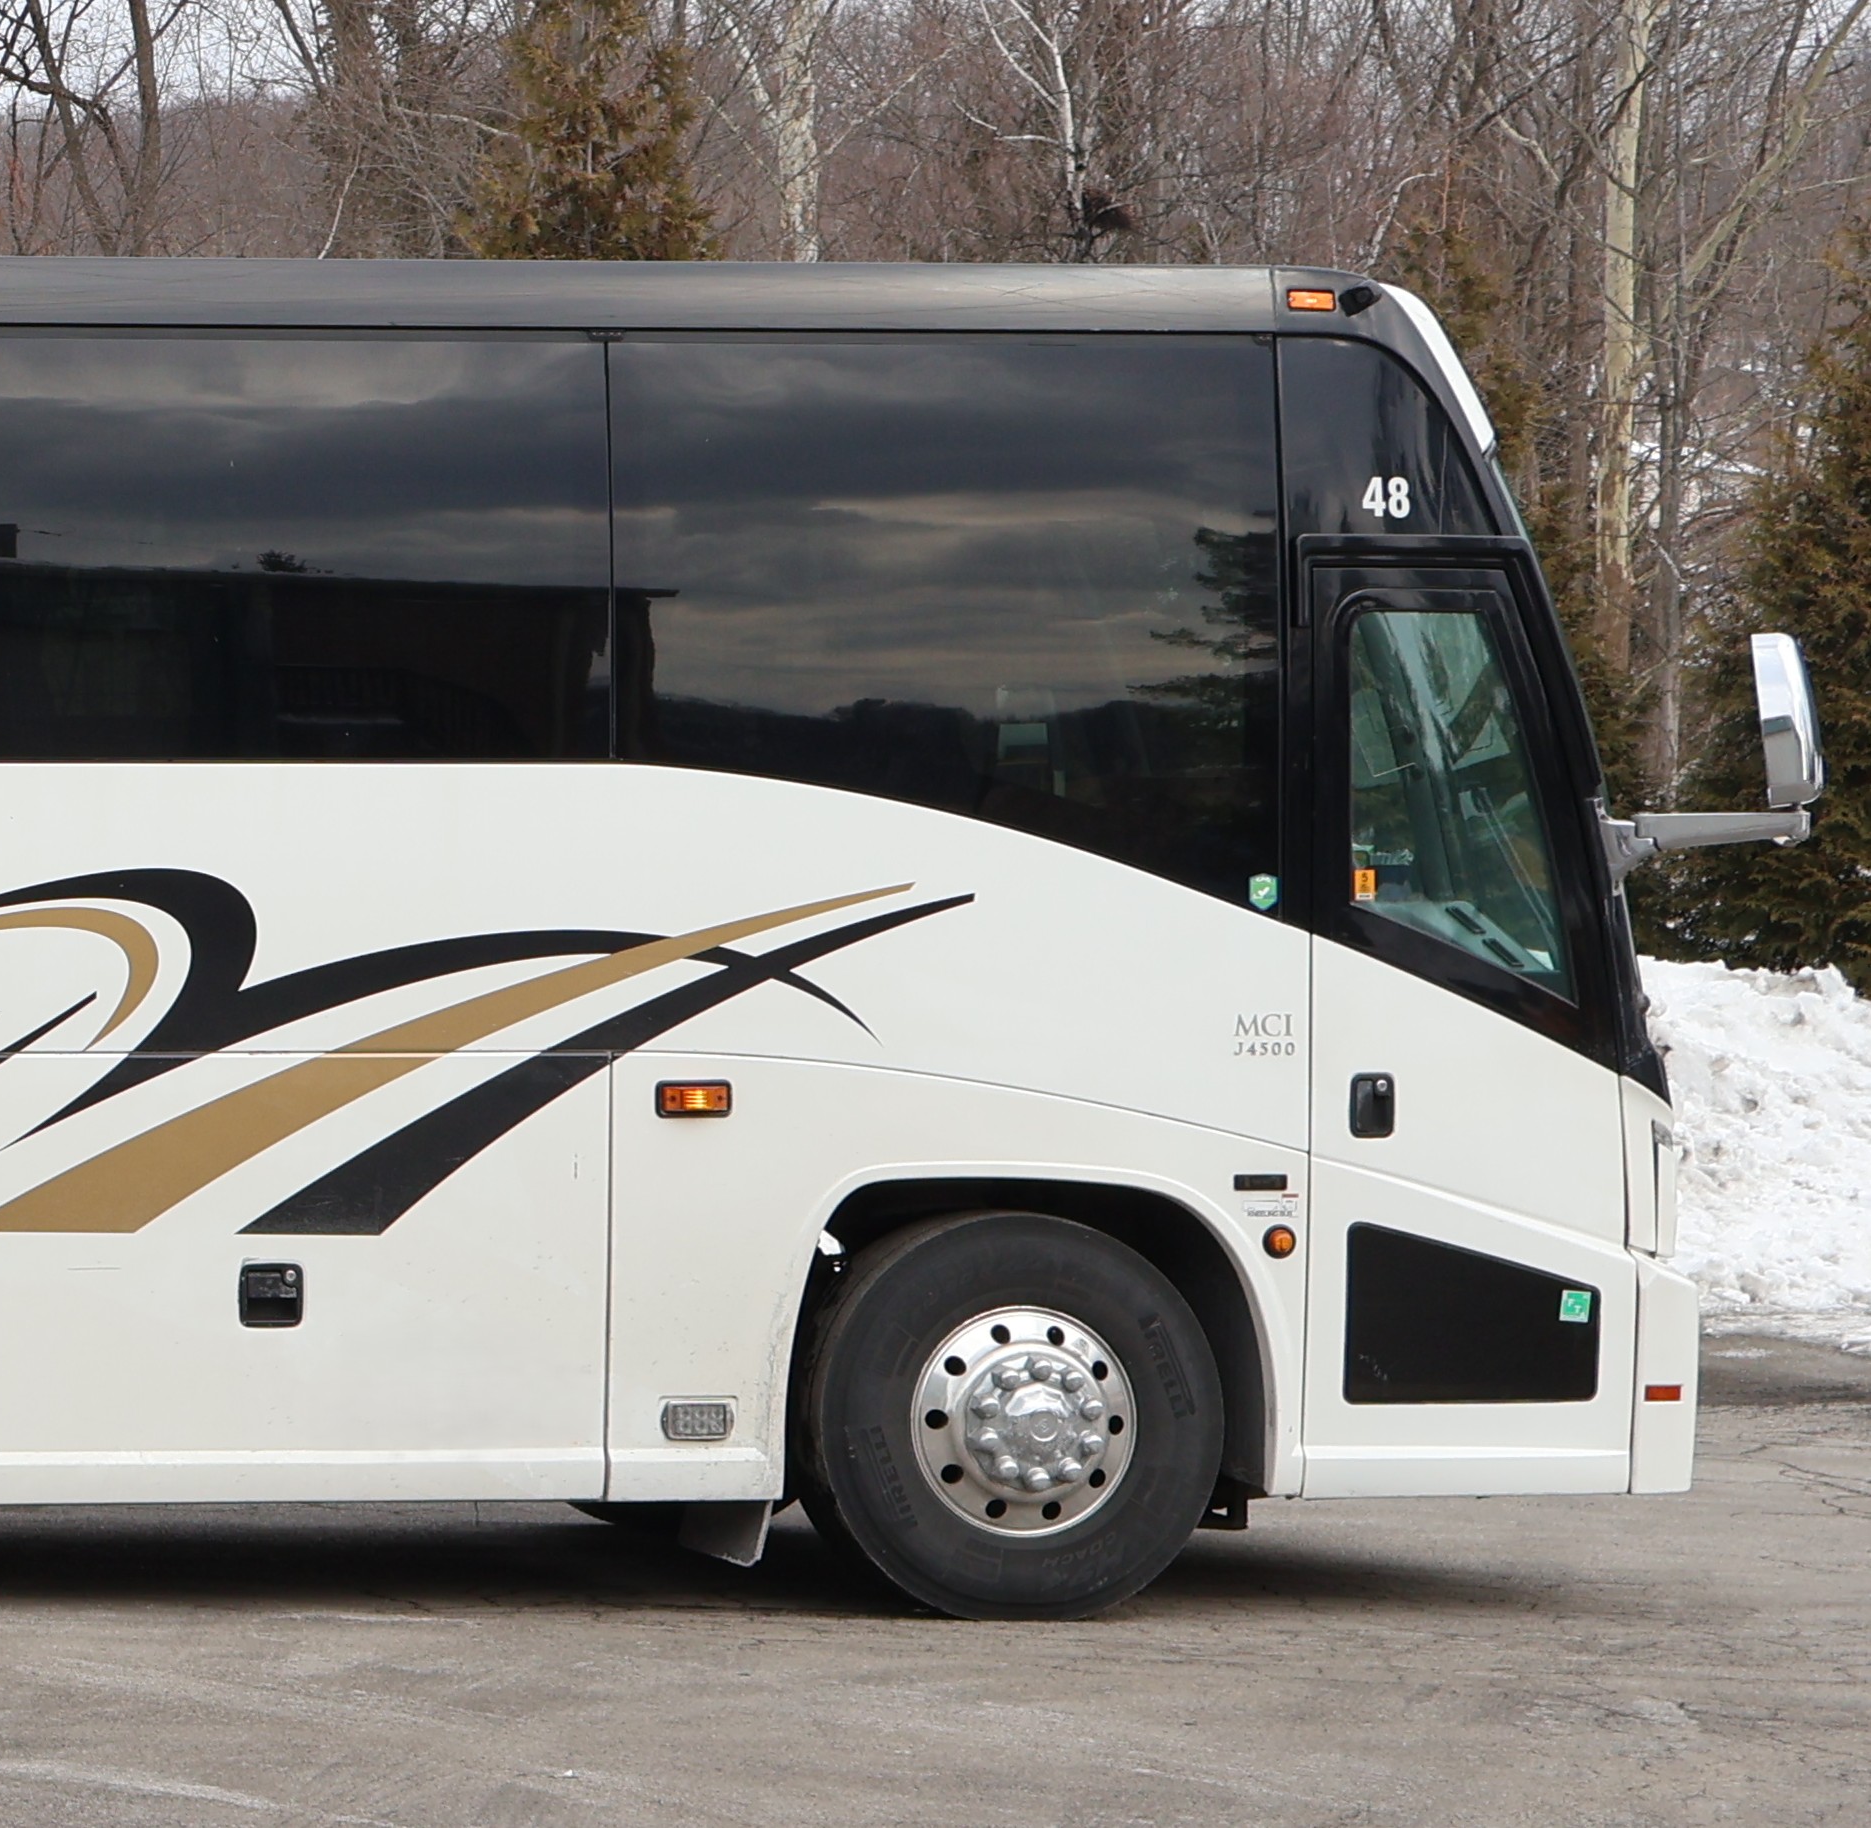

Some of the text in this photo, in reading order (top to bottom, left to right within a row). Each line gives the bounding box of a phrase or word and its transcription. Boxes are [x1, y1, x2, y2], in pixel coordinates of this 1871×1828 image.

[1362, 476, 1410, 518] 48
[1234, 1013, 1293, 1037] MCI
[1234, 1042, 1296, 1056] J4500
